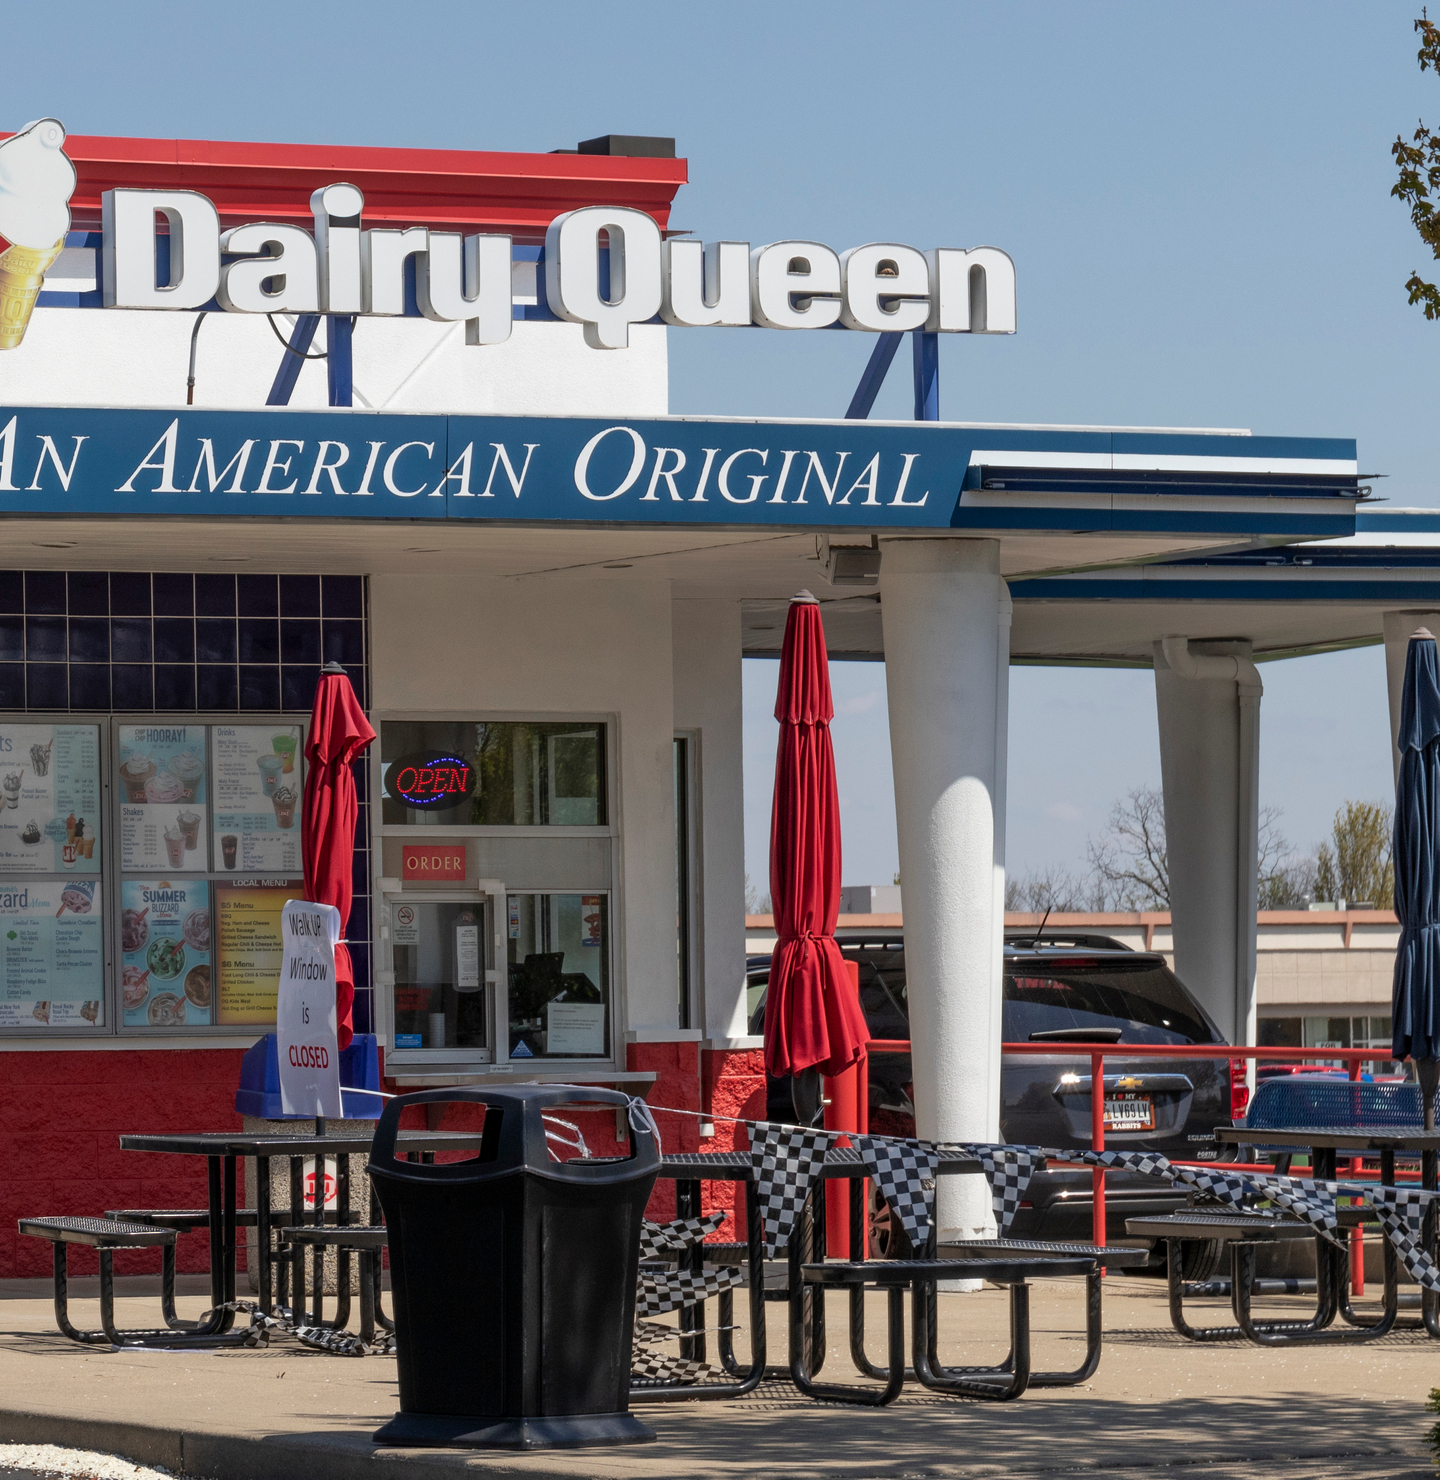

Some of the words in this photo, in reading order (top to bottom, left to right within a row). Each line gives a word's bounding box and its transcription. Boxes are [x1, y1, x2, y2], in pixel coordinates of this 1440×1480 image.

[102, 183, 513, 345] Dairy
[546, 206, 1017, 349] Queen
[114, 418, 540, 498] AMERICAN
[574, 426, 929, 506] ORIGINAL
[146, 728, 186, 743] HOORAY!
[217, 728, 236, 736] Drinks
[396, 767, 469, 794] OPEN
[122, 807, 144, 816] Shakes
[406, 856, 462, 871] ORDER
[232, 879, 260, 887] LOCAL
[261, 879, 288, 887] MENU
[142, 890, 187, 903] SUMMER
[151, 903, 180, 913] BLIZZARD
[289, 912, 311, 936] Walk
[290, 956, 328, 981] Window
[302, 1001, 310, 1024] is
[288, 1044, 329, 1069] CLOSED
[1112, 1122, 1142, 1130] RABBITS
[1196, 1151, 1218, 1160] PORTER
